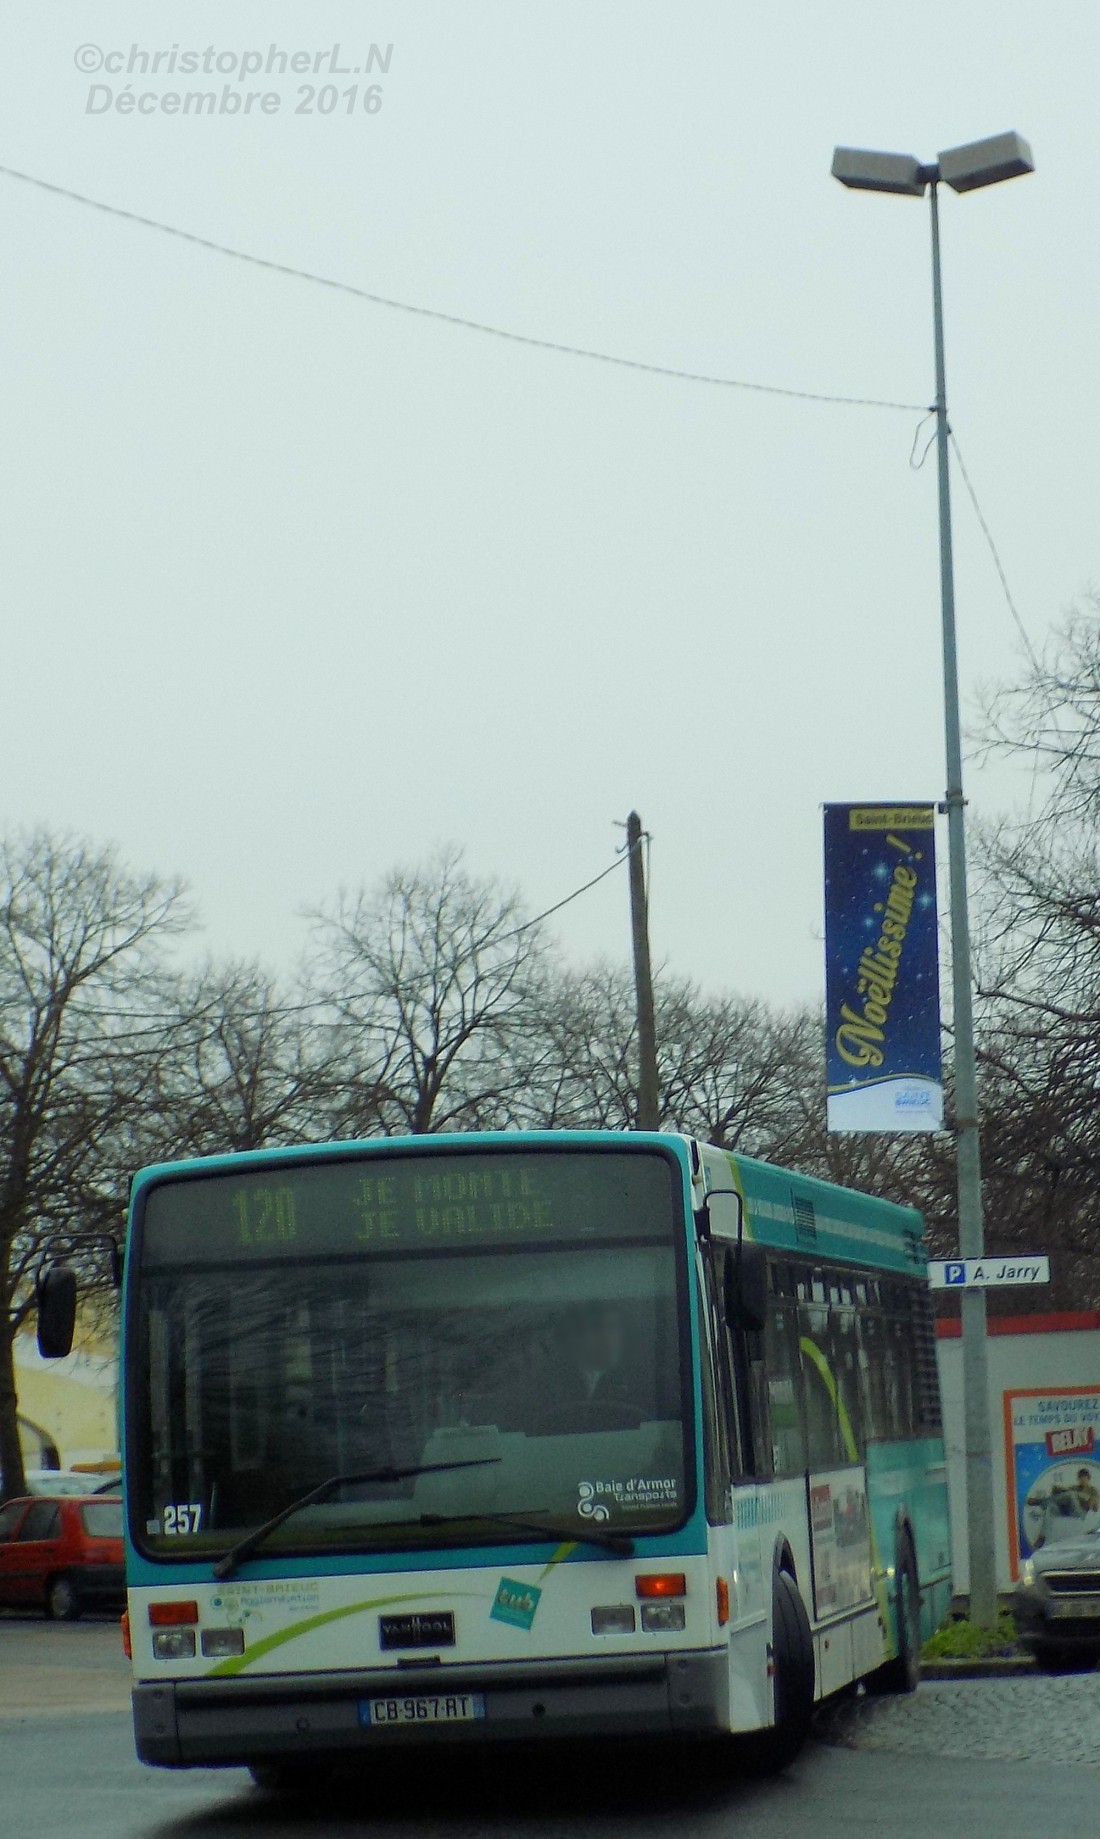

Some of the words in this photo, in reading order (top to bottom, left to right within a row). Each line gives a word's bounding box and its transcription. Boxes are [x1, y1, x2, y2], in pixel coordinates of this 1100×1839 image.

[234, 1186, 297, 1242] 120
[354, 1177, 396, 1206] JE
[415, 1168, 538, 1203] MONTE
[355, 1209, 399, 1240] JE
[415, 1200, 553, 1235] VALIDE
[974, 1266, 990, 1280] A.
[996, 1265, 1040, 1281] Jarry
[1038, 1399, 1099, 1413] SAVOUREZ
[1029, 1412, 1061, 1425] TEMPS
[595, 1480, 623, 1493] Baie
[626, 1479, 676, 1492] d'Armor
[614, 1490, 677, 1502] Transports
[163, 1503, 201, 1535] 257
